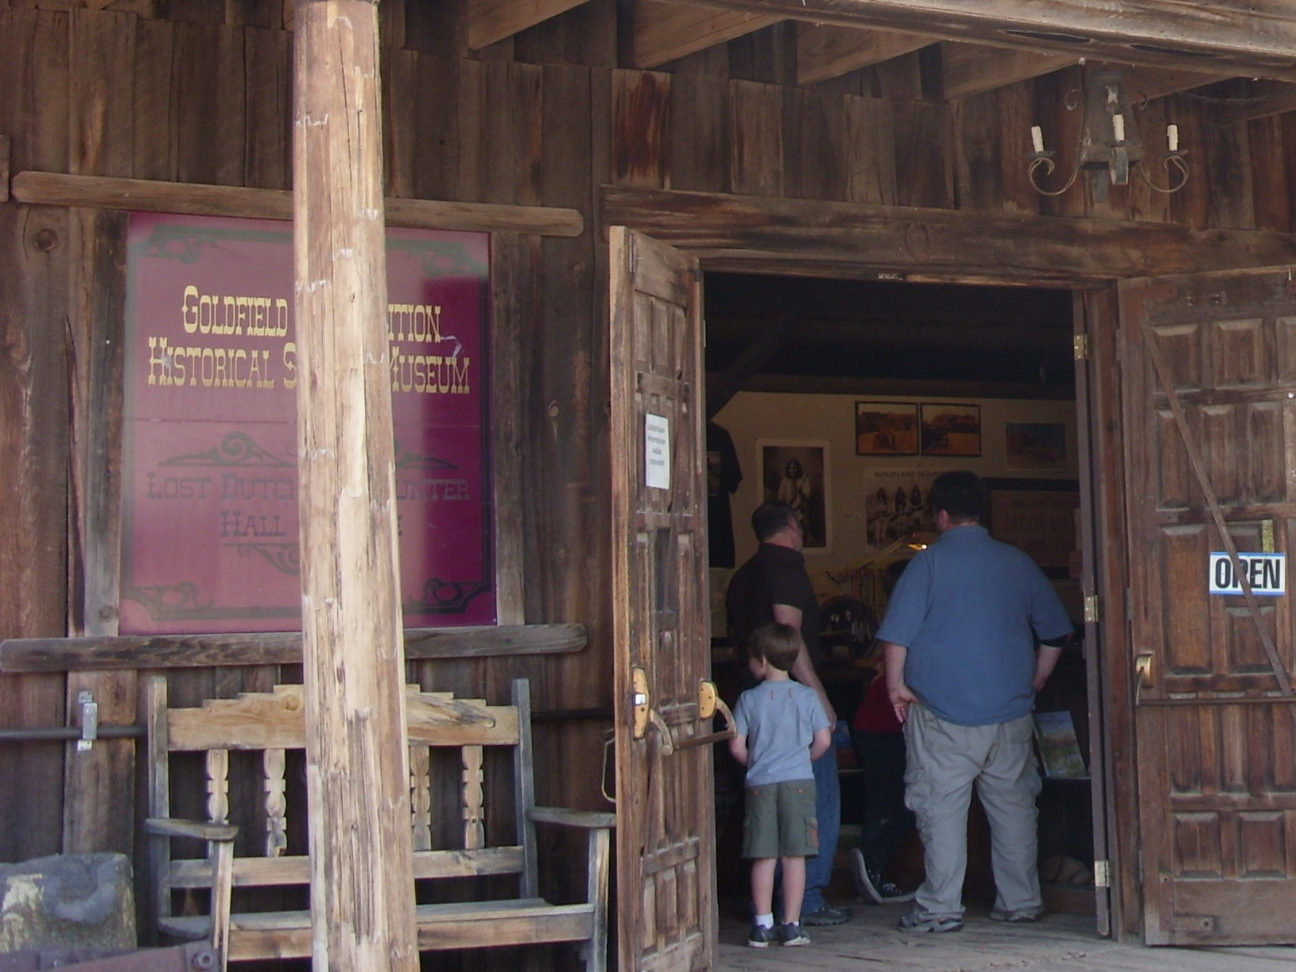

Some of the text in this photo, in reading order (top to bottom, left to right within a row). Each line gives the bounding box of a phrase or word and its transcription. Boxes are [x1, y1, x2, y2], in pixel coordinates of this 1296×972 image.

[181, 285, 442, 344] GOLDFIELD ITION
[147, 336, 275, 389] HISTORICAL
[146, 471, 212, 500] LOST
[396, 478, 471, 501] UNTER
[220, 510, 288, 537] HALL
[1215, 558, 1281, 589] OPEN
